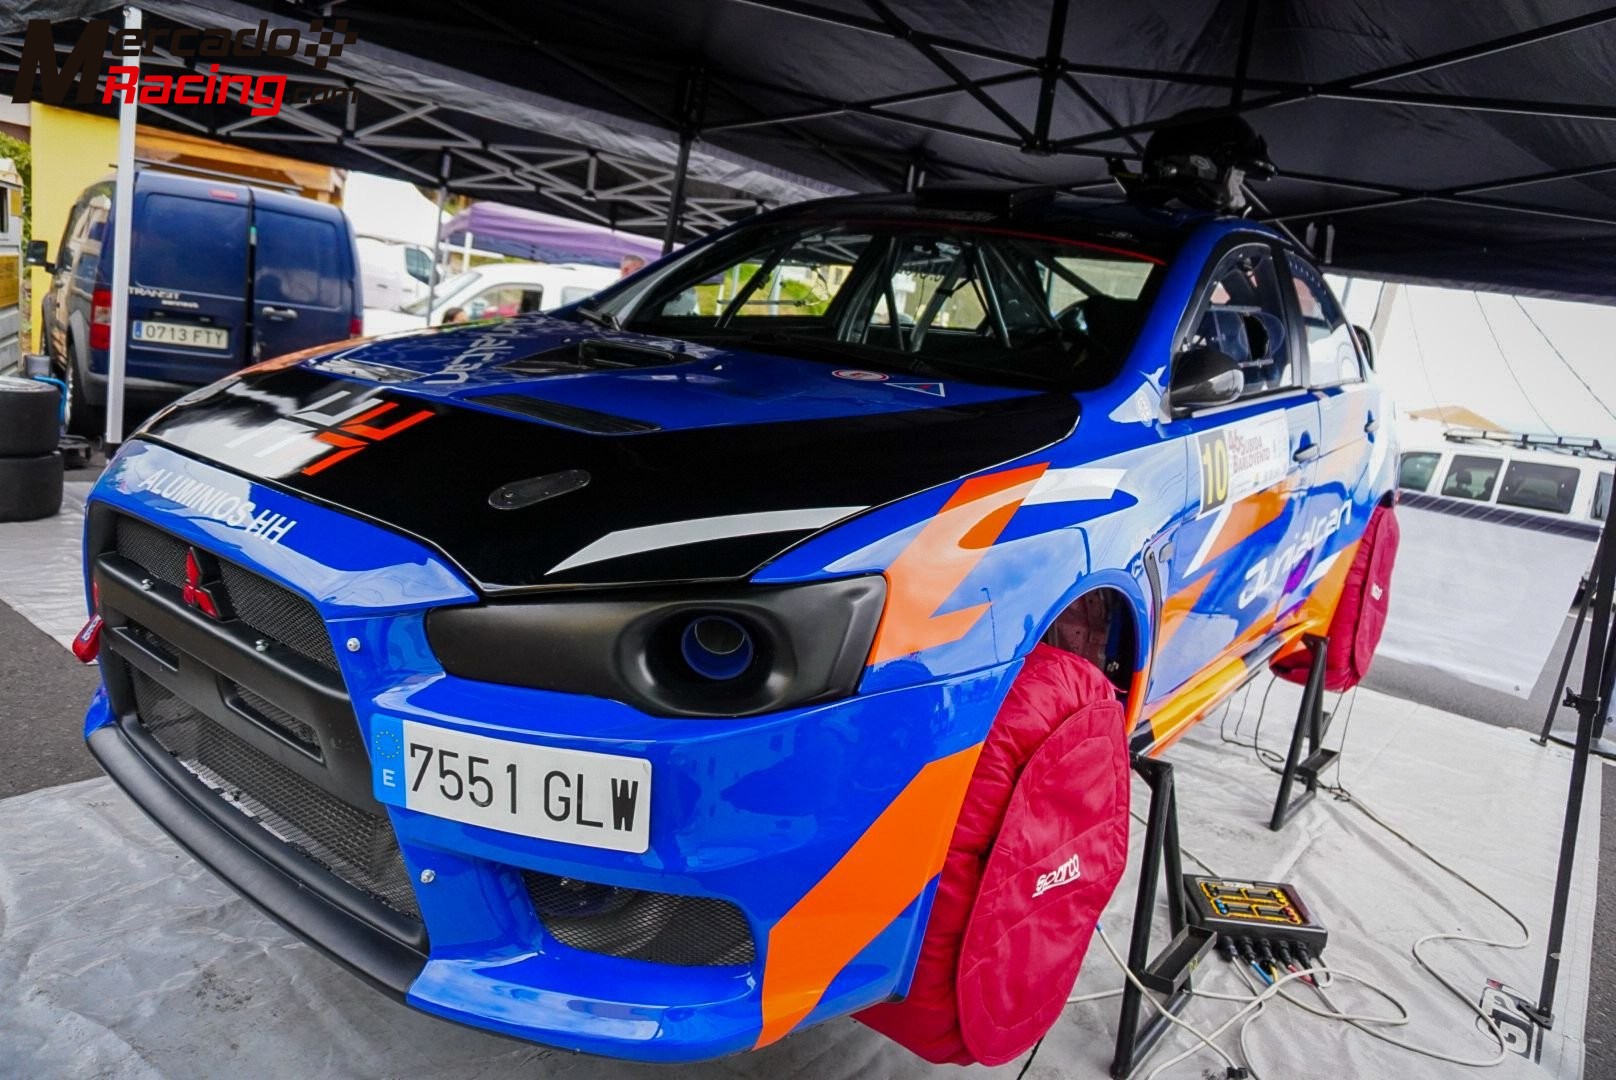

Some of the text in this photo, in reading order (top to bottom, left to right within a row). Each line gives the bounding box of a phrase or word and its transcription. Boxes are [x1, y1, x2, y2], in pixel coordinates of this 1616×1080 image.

[145, 324, 223, 345] 0713 FTY
[1202, 439, 1228, 505] 10
[138, 468, 297, 545] ALUMINIOS HH
[382, 769, 396, 788] E
[409, 742, 639, 833] 7551 GLW
